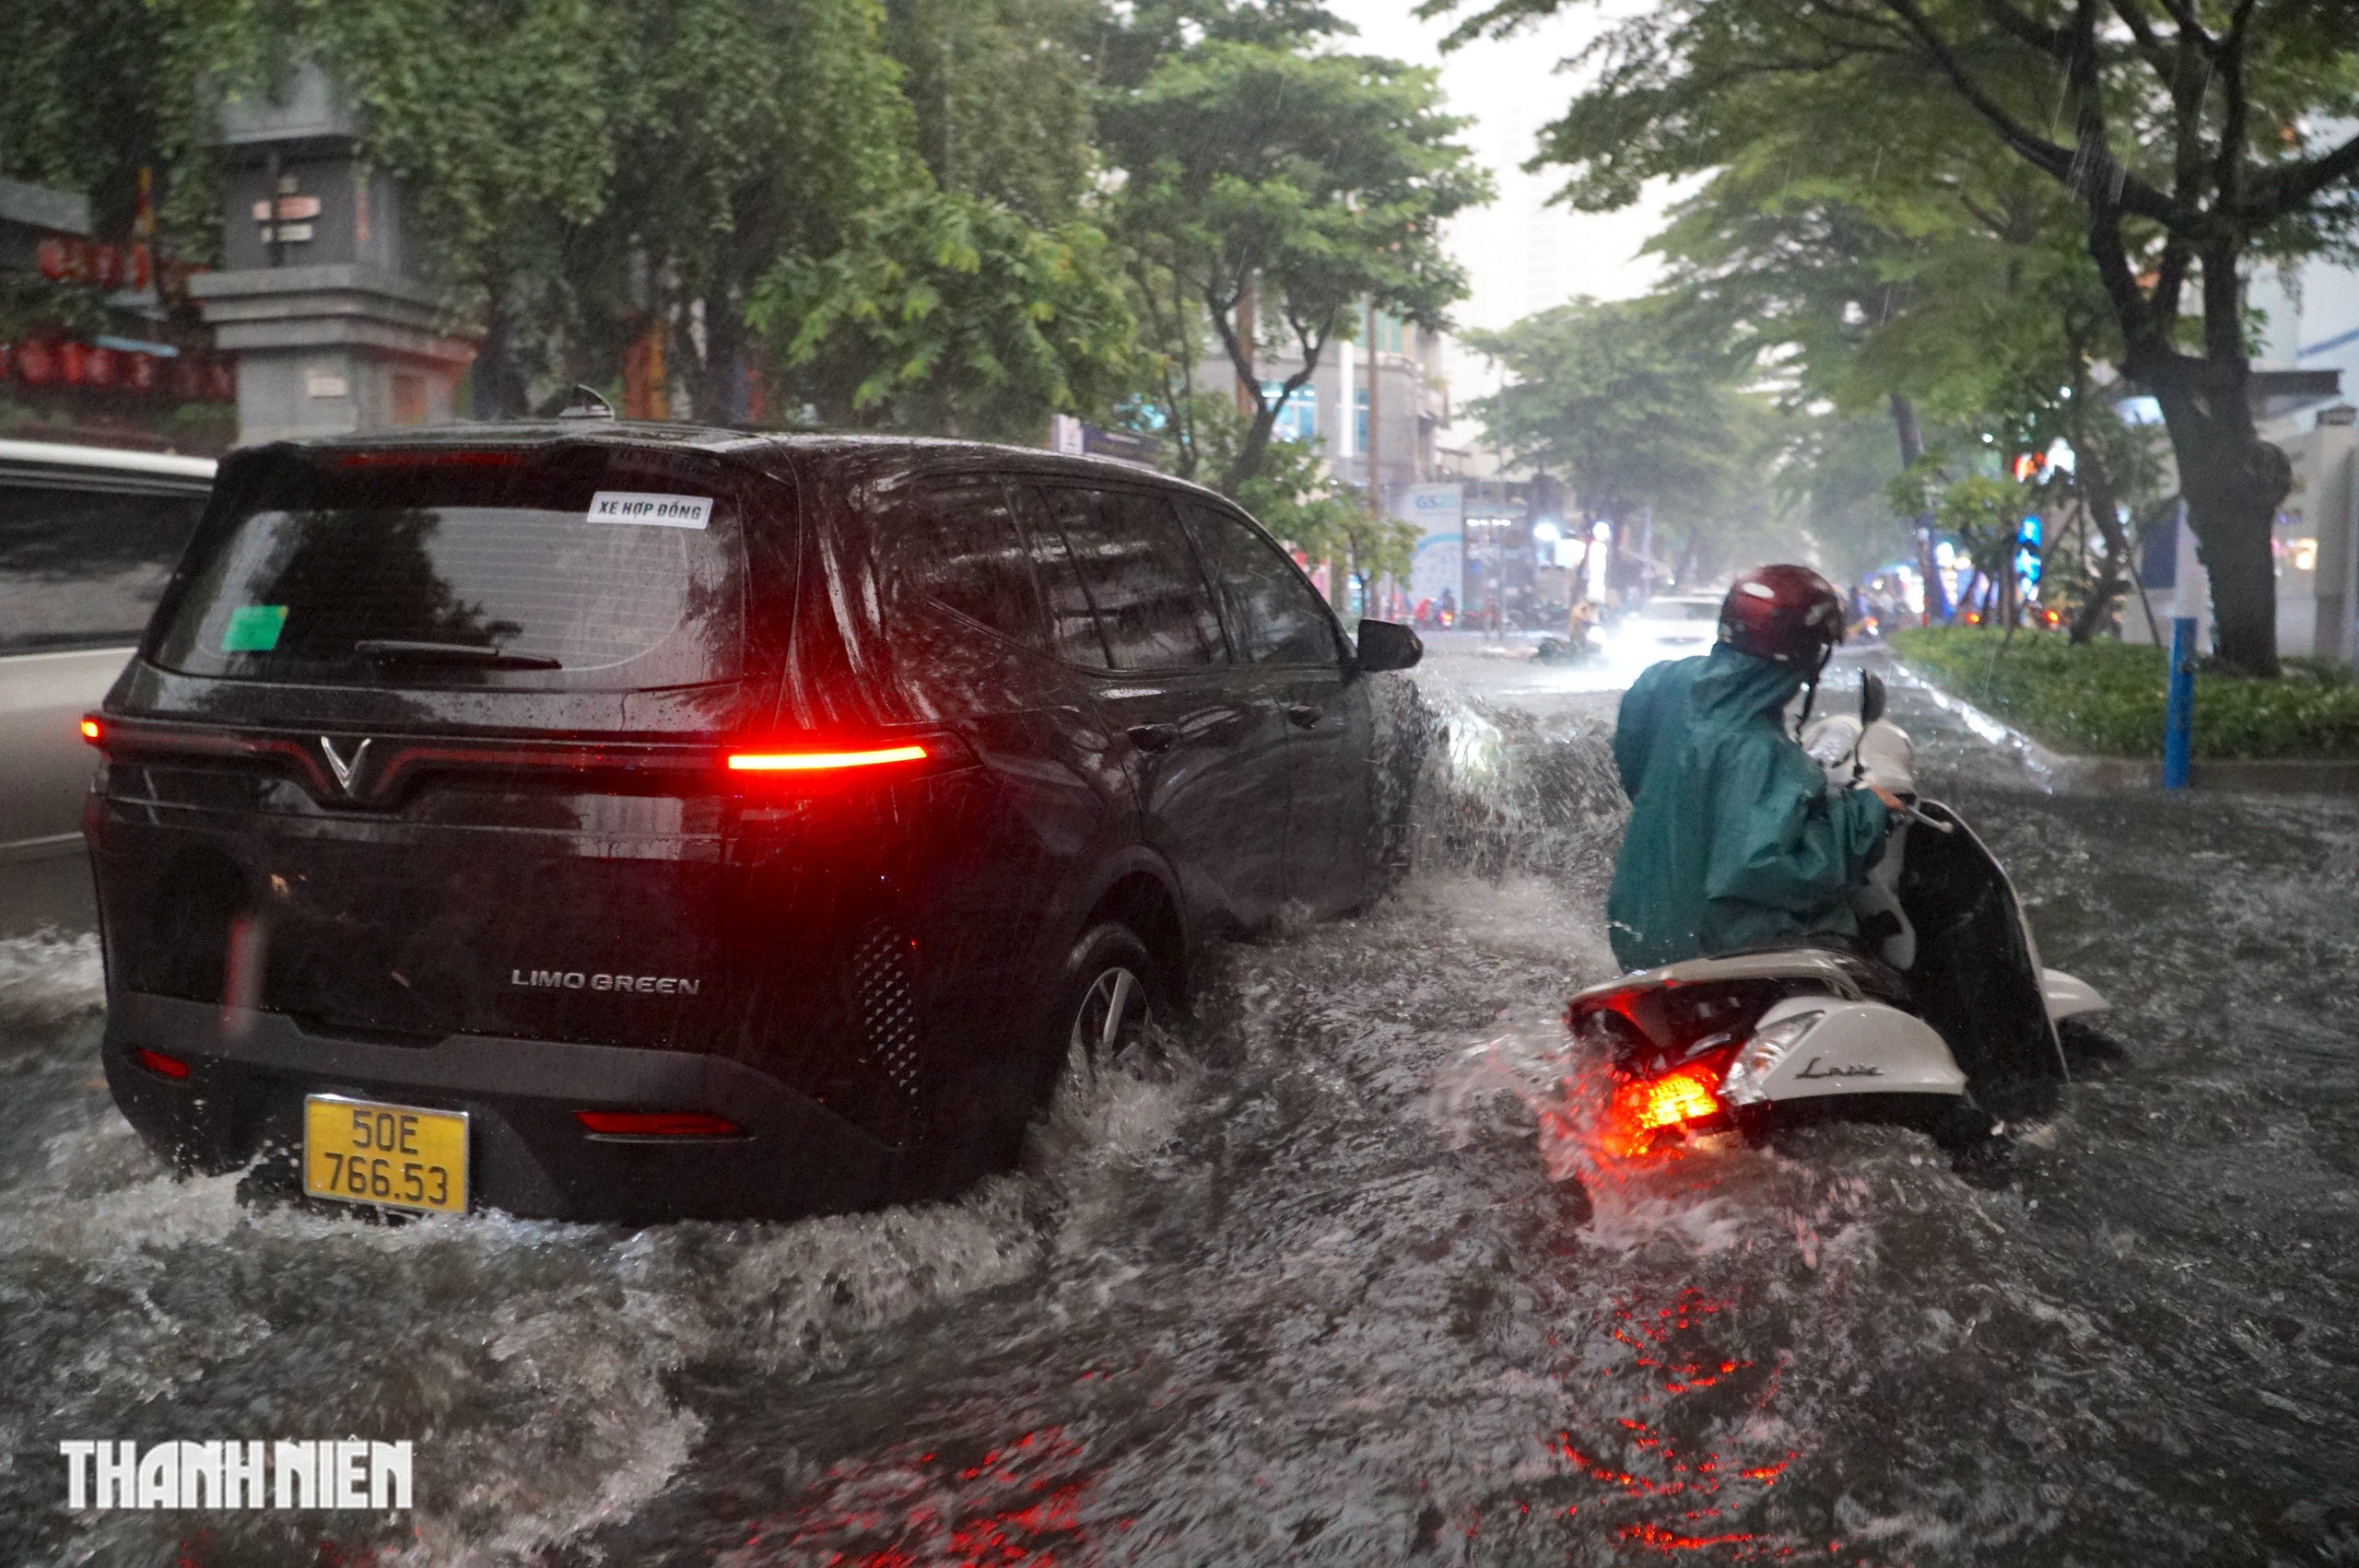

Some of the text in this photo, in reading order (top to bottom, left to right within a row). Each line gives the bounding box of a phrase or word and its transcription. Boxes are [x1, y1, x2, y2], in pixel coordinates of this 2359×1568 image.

[598, 501, 619, 515] XE
[621, 501, 654, 519] HỢP
[511, 969, 700, 995] LIMO GREEN
[352, 1109, 419, 1155] 50E
[324, 1152, 448, 1205] 766.53
